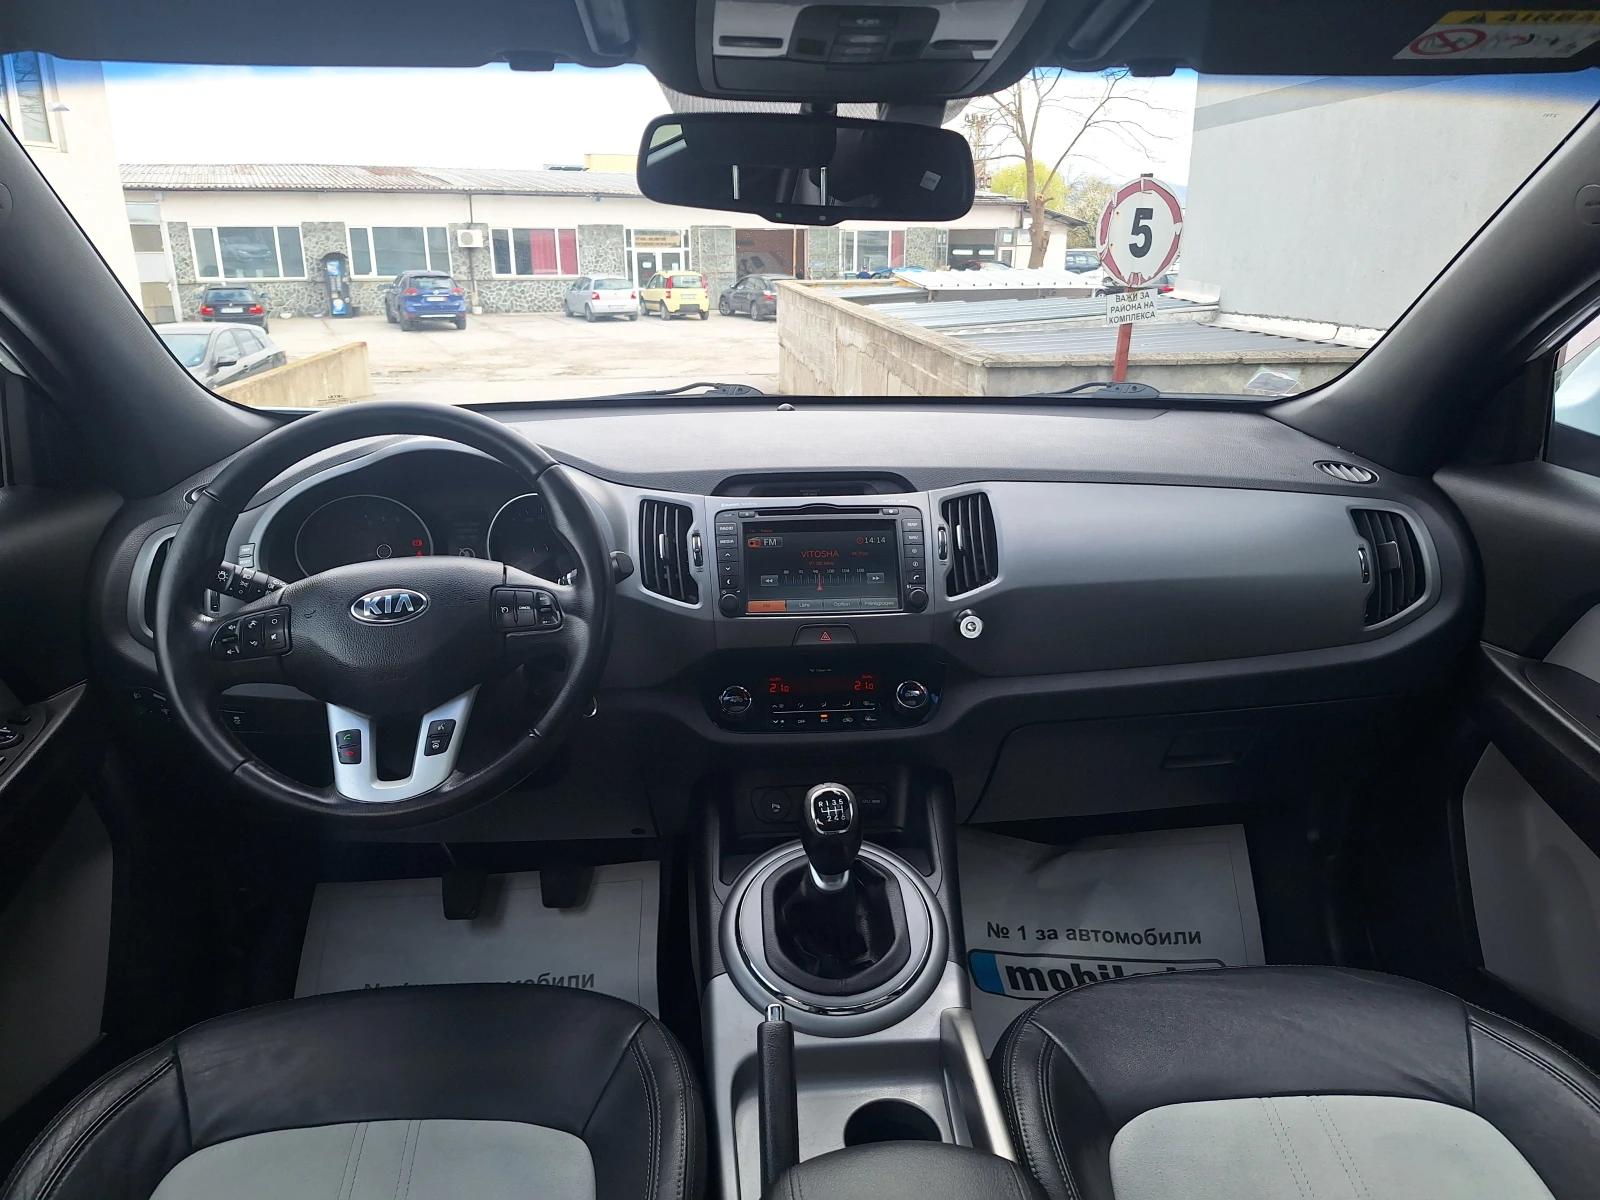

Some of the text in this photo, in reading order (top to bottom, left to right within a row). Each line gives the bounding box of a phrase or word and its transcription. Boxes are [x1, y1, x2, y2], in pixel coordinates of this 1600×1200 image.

[1129, 208, 1153, 258] 5
[1115, 291, 1150, 303] ВАЖИ ЗА
[1110, 301, 1155, 313] РАЙОНА НА
[1108, 311, 1156, 324] КОМПЛЕКСА
[763, 538, 777, 546] FM
[864, 536, 886, 544] 14:14
[800, 550, 840, 558] VITOSHA
[363, 593, 415, 617] KIA
[1017, 925, 1027, 941] 1
[1035, 927, 1059, 941] за
[1065, 927, 1202, 945] автомобили
